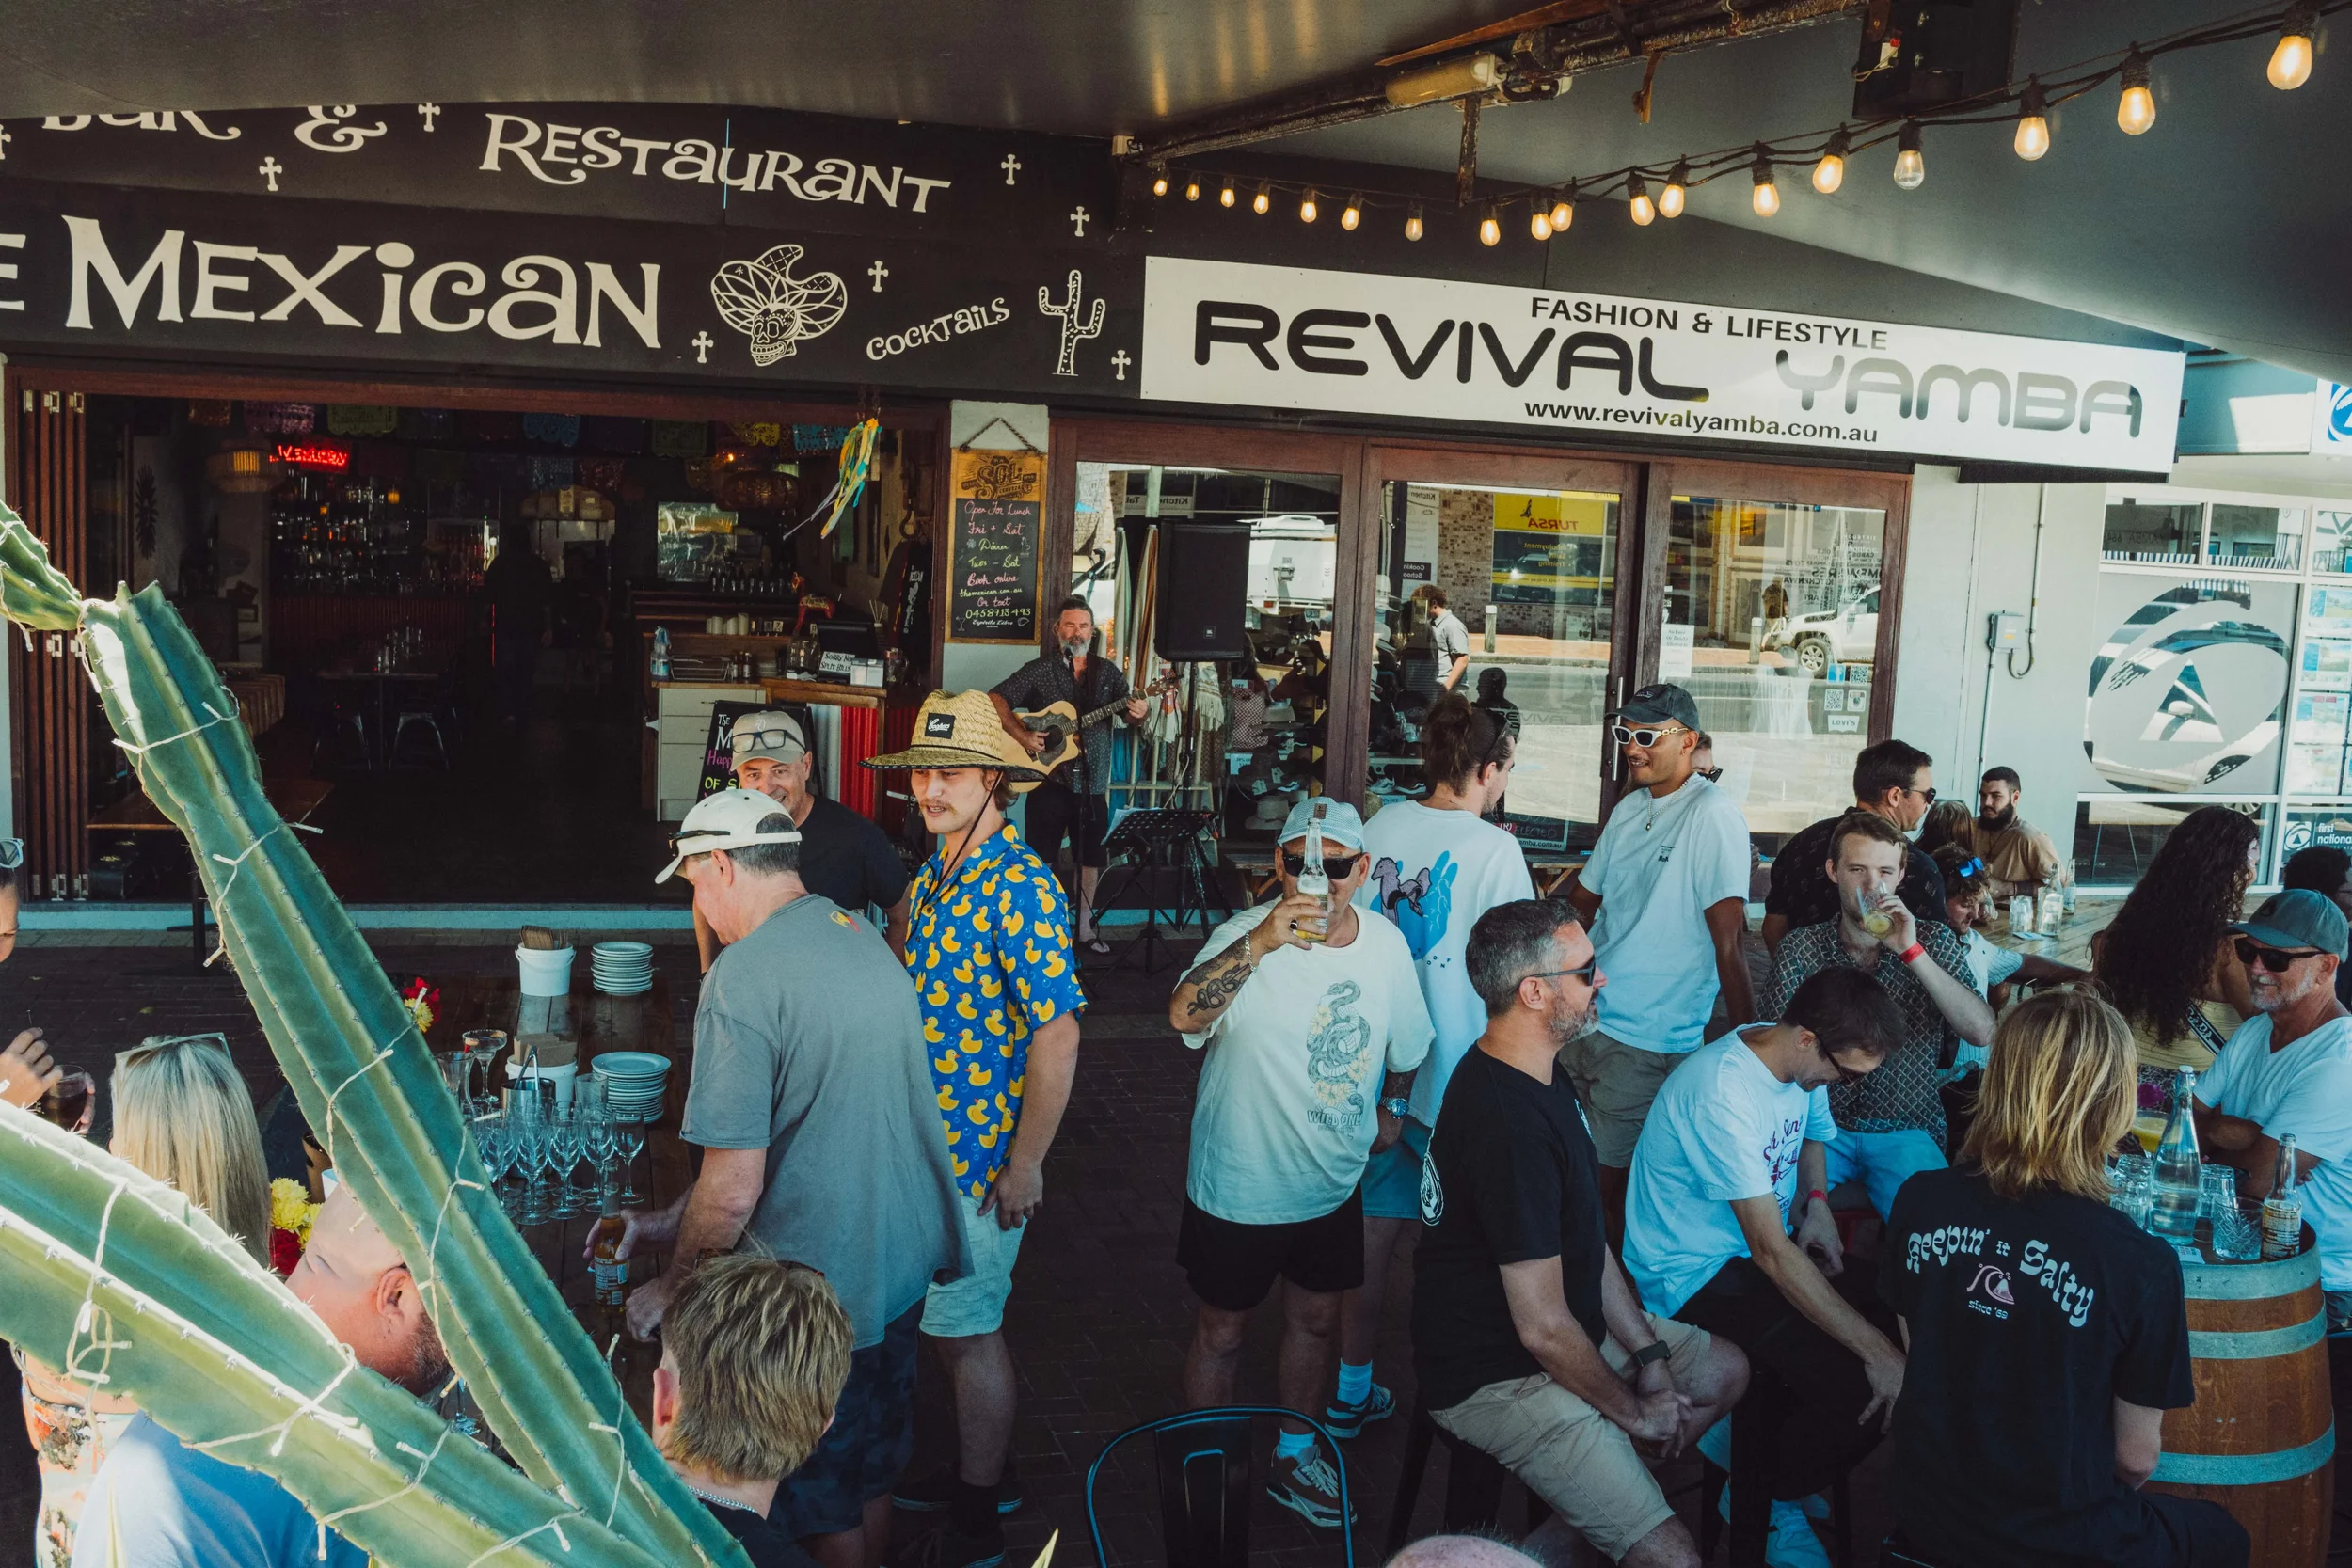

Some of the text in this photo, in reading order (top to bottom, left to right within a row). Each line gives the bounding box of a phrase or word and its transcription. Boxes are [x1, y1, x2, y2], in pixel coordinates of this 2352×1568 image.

[1531, 297, 1887, 351] FASHION & LIFESTYLE
[1194, 300, 2143, 438] REVIVAL YAMBA
[1524, 402, 1878, 443] www.revivalyamba.com.au
[964, 500, 1031, 521] Open For Lunch
[968, 522, 987, 534] Fri
[1003, 523, 1025, 535] Sat
[979, 538, 1009, 551] Dinner
[1003, 555, 1021, 568] Sat
[967, 571, 1019, 587] Book online
[977, 596, 1011, 608] Or text
[705, 776, 722, 790] OF
[2318, 822, 2334, 833] first
[2019, 1239, 2094, 1328] Salty
[1968, 1299, 1992, 1316] since
